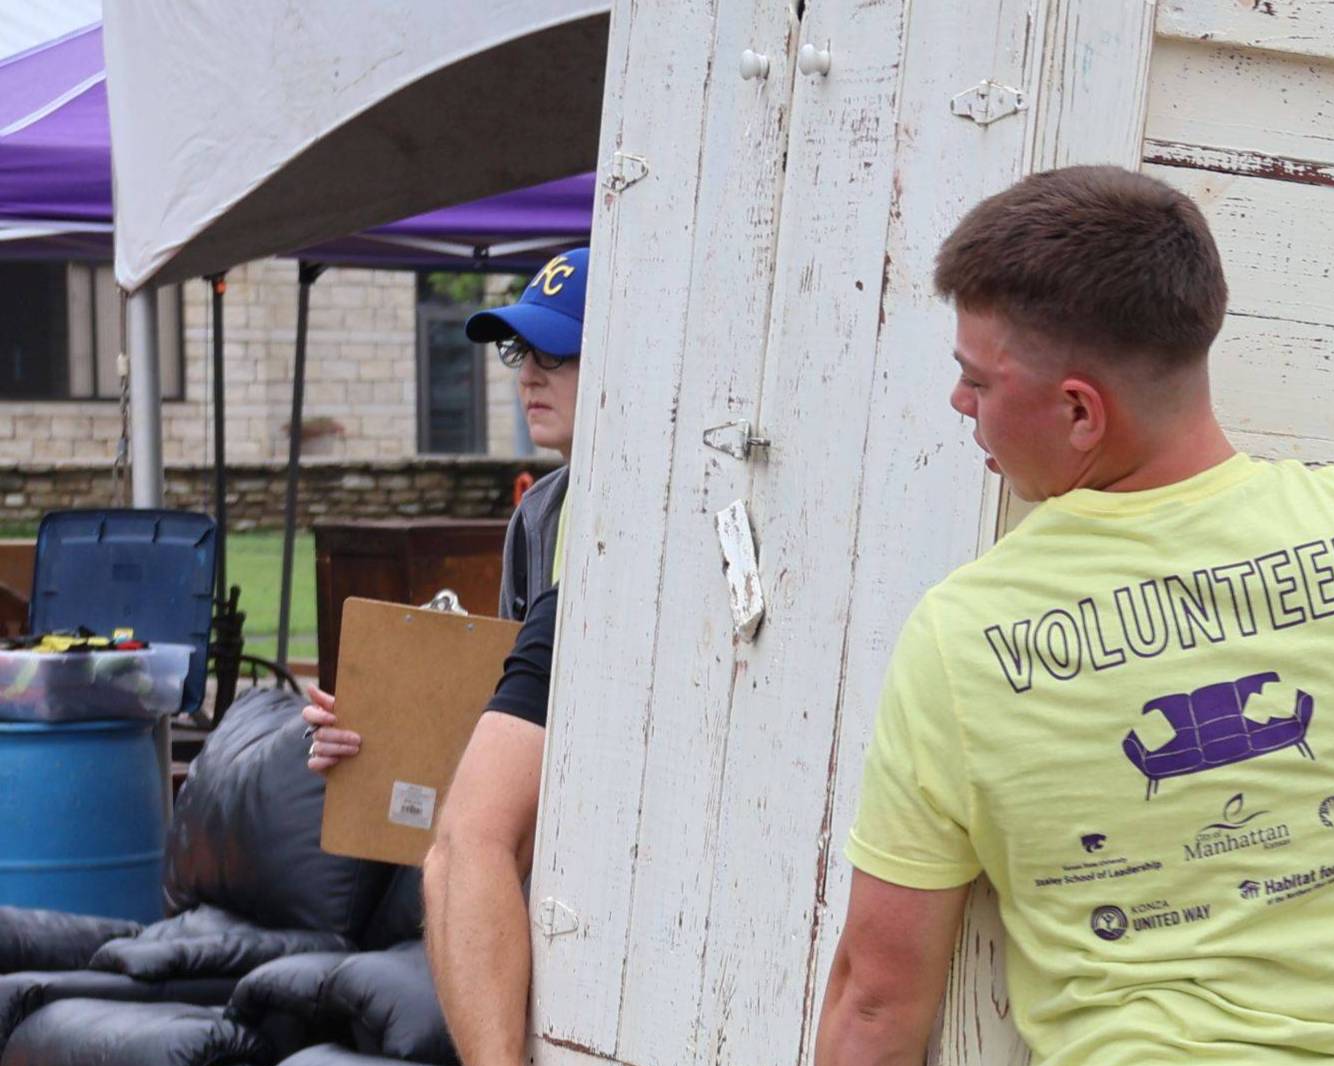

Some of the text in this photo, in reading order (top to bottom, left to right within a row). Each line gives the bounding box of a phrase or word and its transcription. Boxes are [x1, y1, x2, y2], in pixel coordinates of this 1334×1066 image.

[1183, 824, 1289, 861] Manhattan
[1064, 871, 1095, 884] School
[1264, 869, 1316, 895] Habitat
[1132, 903, 1211, 932] UNITED WAY
